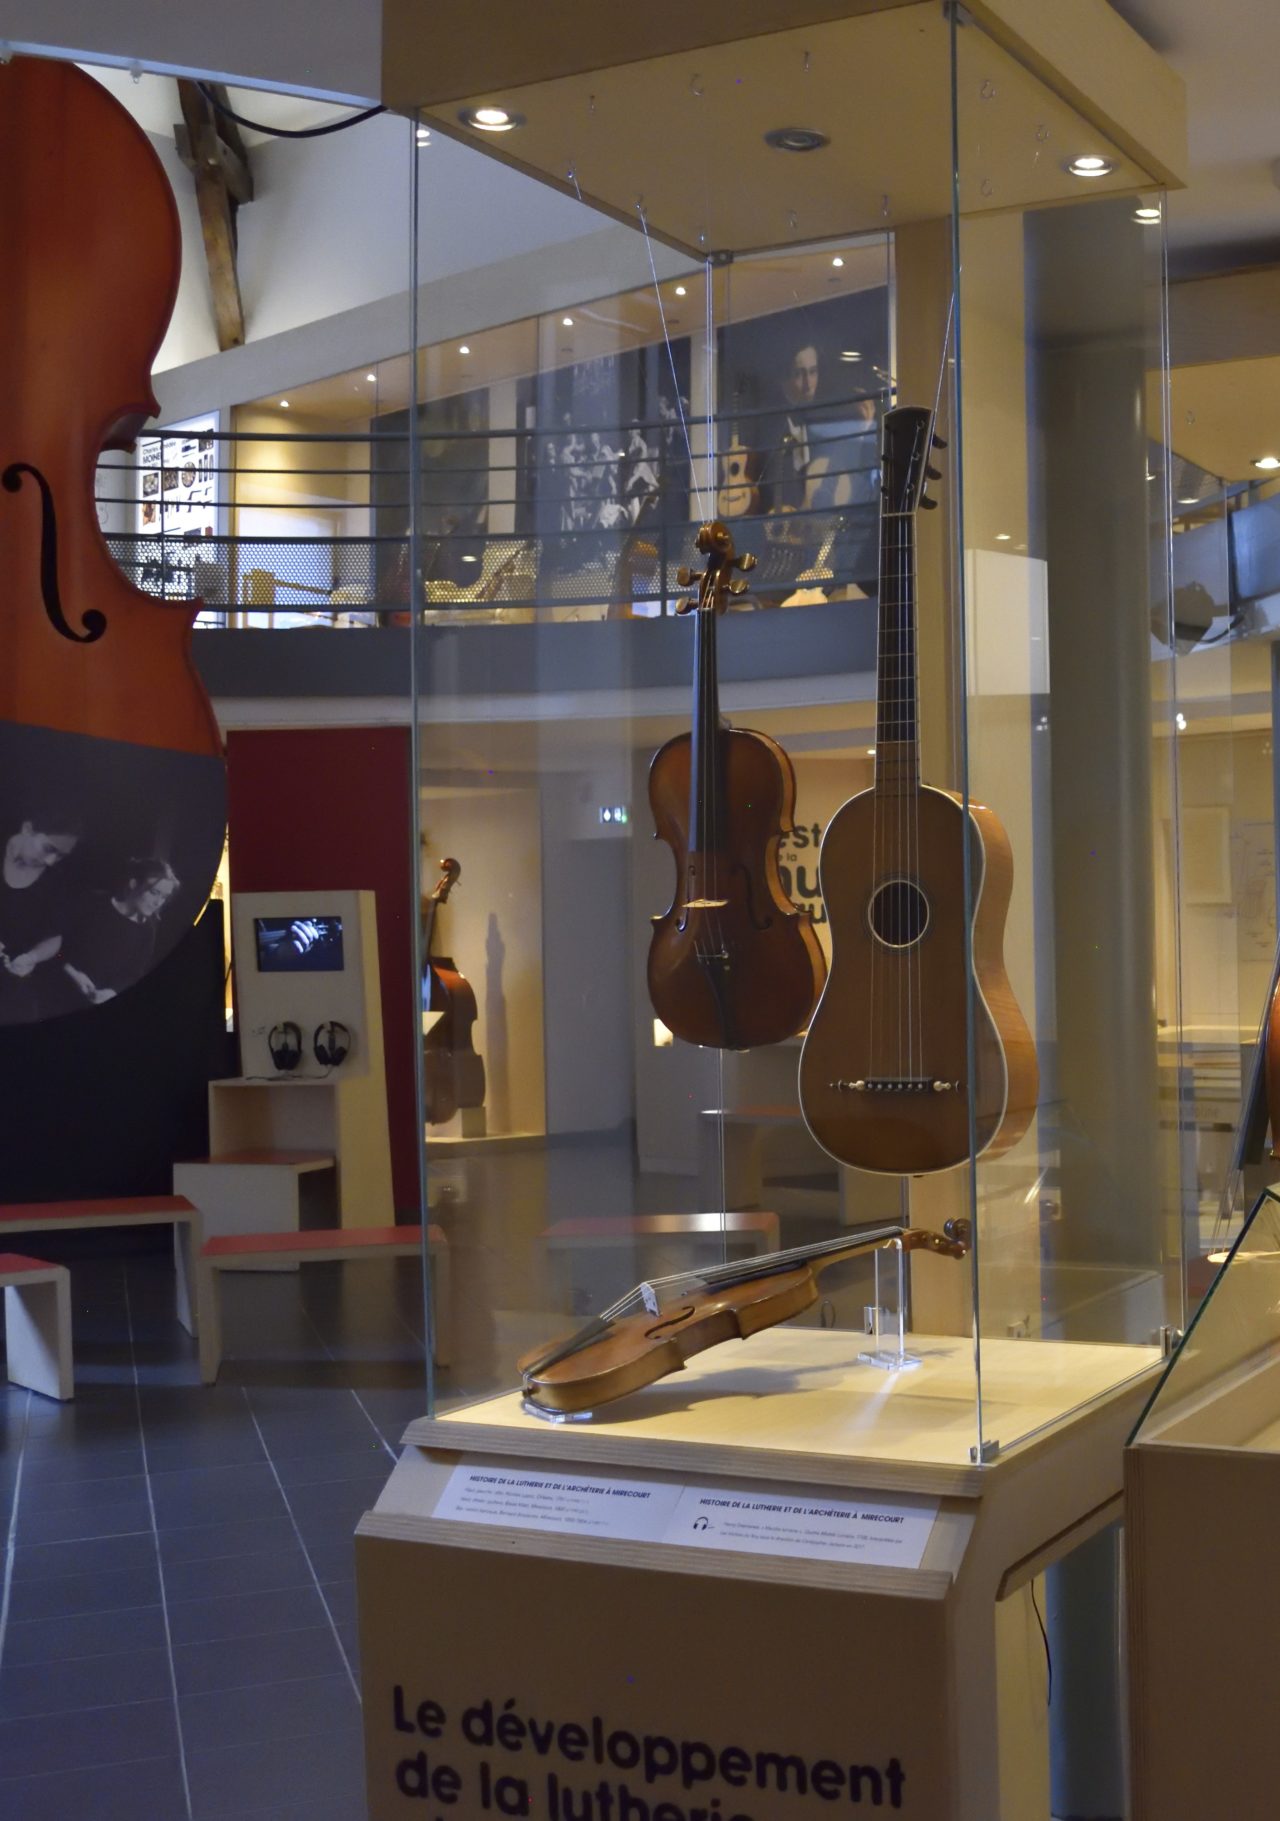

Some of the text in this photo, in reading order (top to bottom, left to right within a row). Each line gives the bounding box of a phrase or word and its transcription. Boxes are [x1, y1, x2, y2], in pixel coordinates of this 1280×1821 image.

[470, 1475, 497, 1485] HISTOIRE
[516, 1480, 544, 1489] LUTHERIE
[553, 1483, 562, 1491] DE
[612, 1489, 652, 1499] MIRECOURT
[700, 1498, 731, 1508] HISTOIRE
[752, 1503, 783, 1513] LUTHERIE
[793, 1506, 802, 1514] DE
[861, 1513, 904, 1524] MIRECOURT
[393, 1684, 906, 1809] Le développement
[395, 1750, 462, 1804] de
[480, 1761, 529, 1817] la
